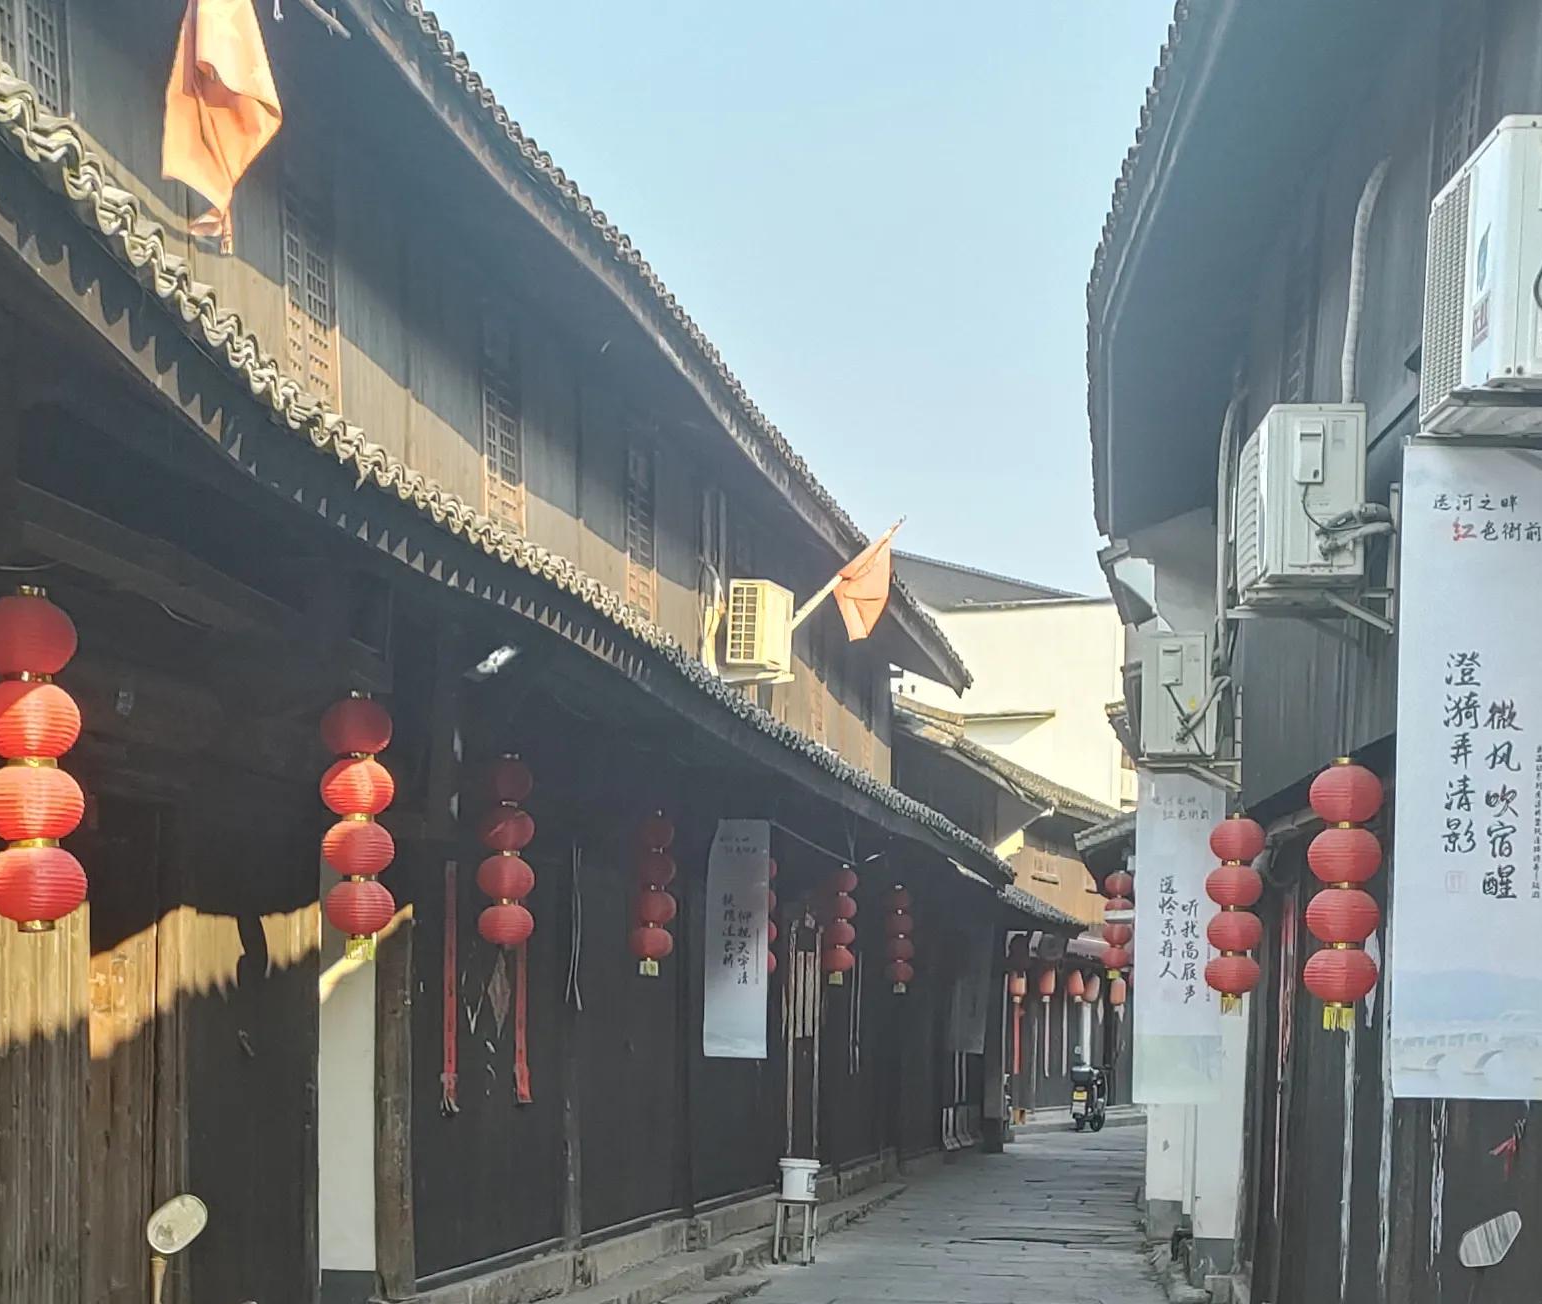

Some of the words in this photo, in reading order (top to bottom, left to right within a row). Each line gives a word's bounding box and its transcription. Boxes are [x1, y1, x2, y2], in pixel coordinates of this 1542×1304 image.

[1433, 493, 1518, 512] 运河之畔
[1453, 517, 1542, 541] 红色衙前
